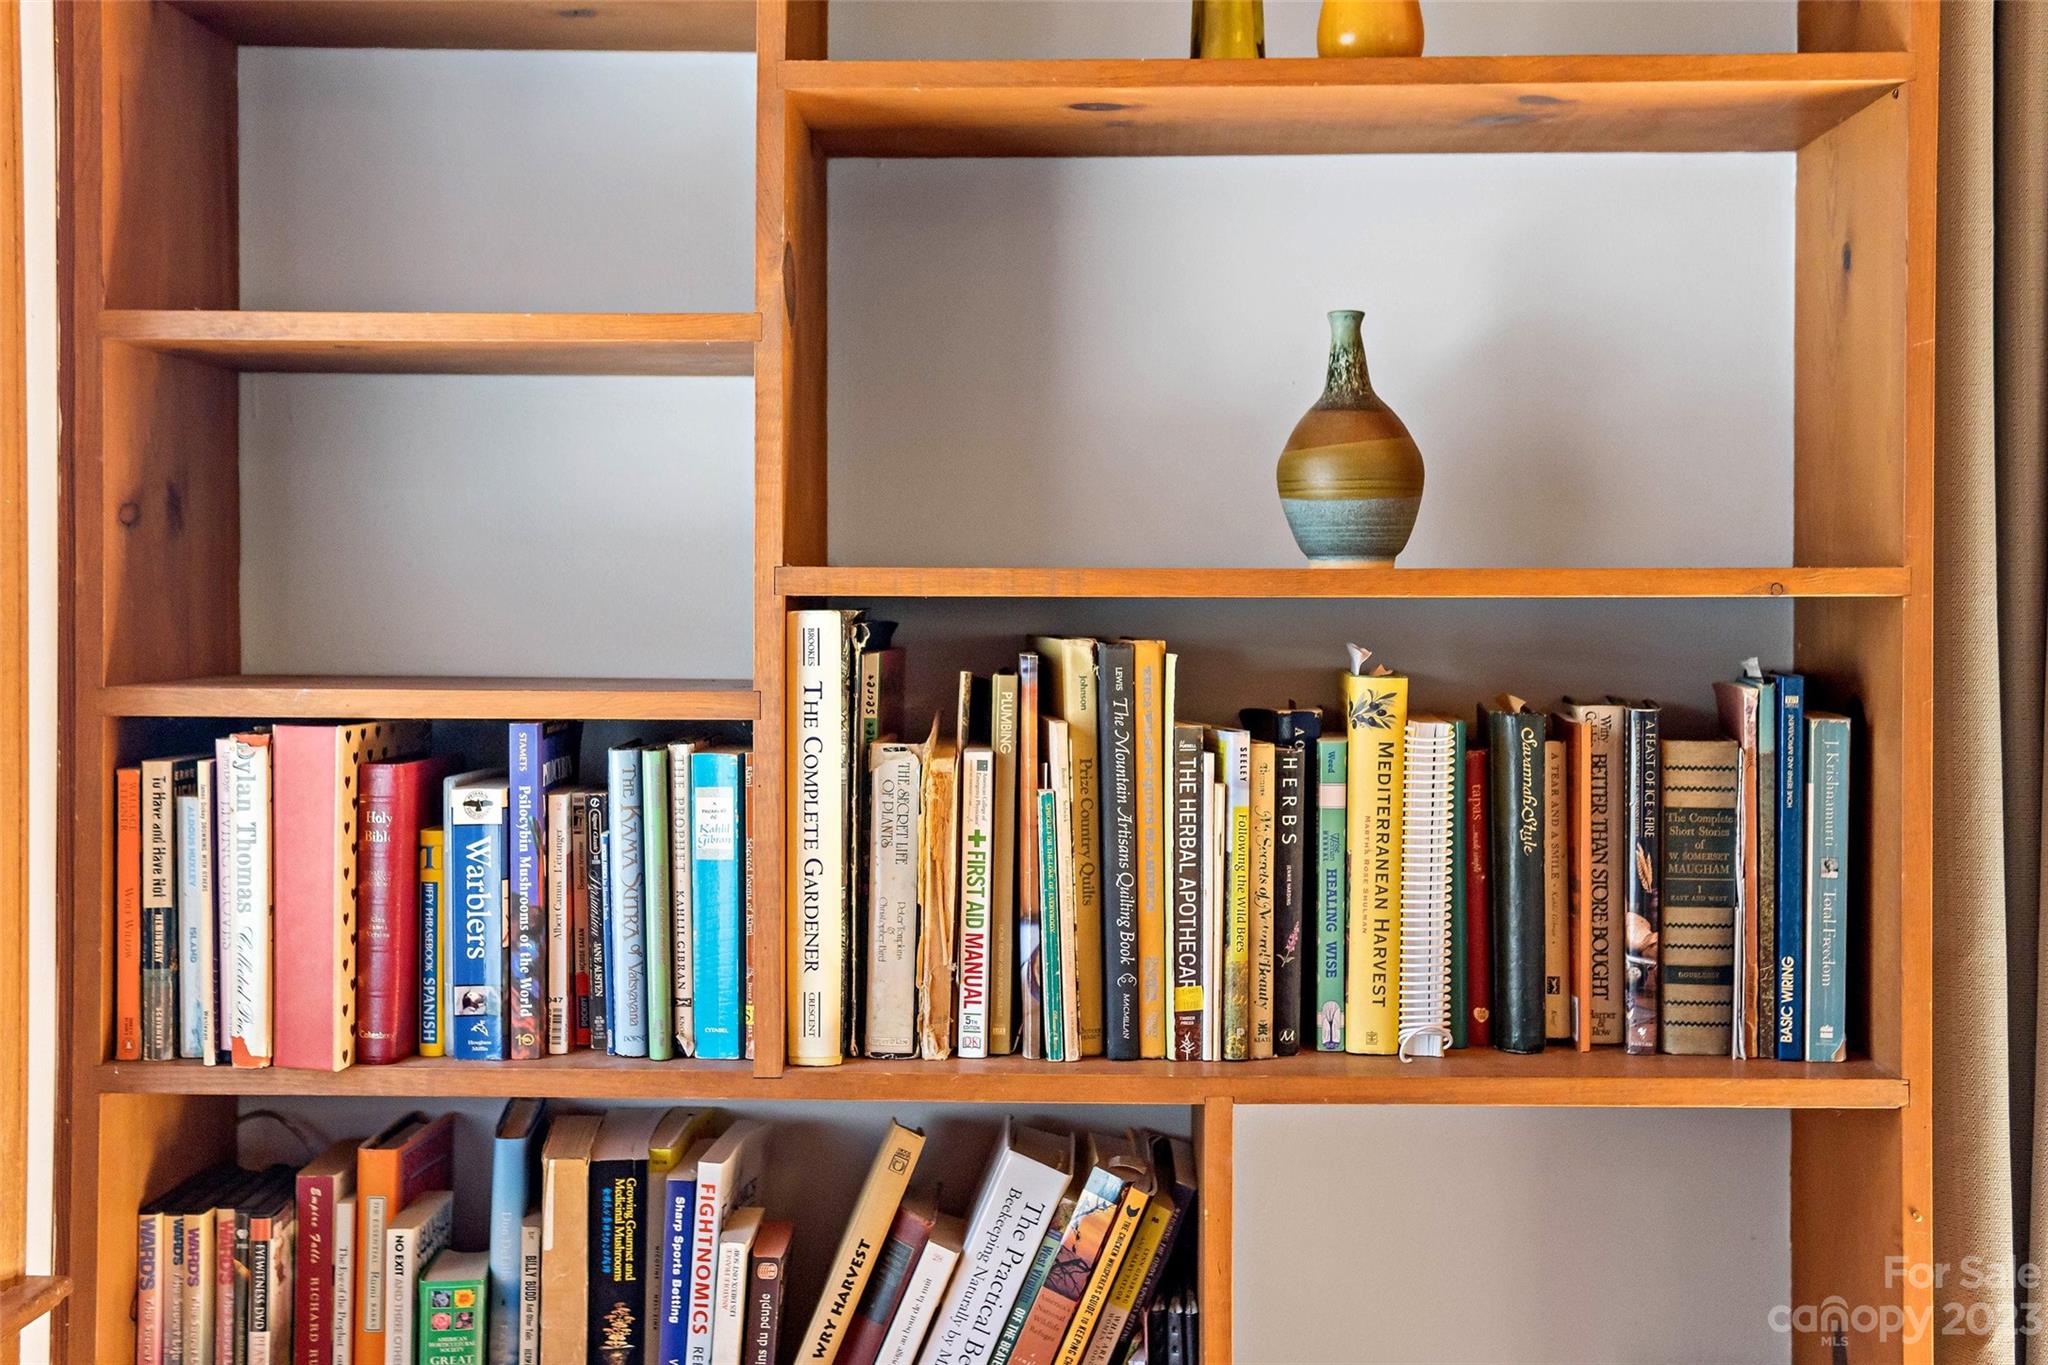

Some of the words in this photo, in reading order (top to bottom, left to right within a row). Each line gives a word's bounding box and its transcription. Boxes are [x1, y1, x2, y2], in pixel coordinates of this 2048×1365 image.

[807, 628, 816, 666] BROOKES
[803, 681, 823, 727] THE
[1079, 675, 1090, 711] Johnson
[1000, 691, 1012, 754] PLUMBING
[1113, 698, 1130, 726] The
[1644, 720, 1655, 730] A
[518, 732, 528, 772] STAMETS
[1328, 750, 1336, 773] Weed
[1644, 733, 1656, 767] FEAST
[1823, 739, 1838, 748] J.
[152, 776, 166, 788] To
[233, 744, 256, 812] Dylan
[622, 764, 638, 798] THE
[674, 755, 684, 789] THE
[898, 763, 910, 786] THE
[1080, 758, 1093, 794] Prize
[1114, 729, 1131, 804] Mountain
[1240, 746, 1248, 782] SEELEY
[1523, 726, 1538, 806] Savannah
[1644, 770, 1655, 786] OF
[803, 736, 823, 850] COMPLETE
[882, 779, 894, 799] OF
[1282, 757, 1298, 845] HERBS
[1591, 754, 1608, 816] BETTER
[1644, 790, 1655, 806] ICE
[1826, 752, 1839, 848] Krishnamurti
[120, 782, 128, 831] STEGNER
[128, 782, 137, 832] WALLACE
[152, 792, 166, 819] Have
[366, 811, 392, 827] Holy
[514, 786, 532, 852] Psilocybin
[896, 788, 910, 838] SECRET
[1666, 811, 1686, 823] The
[1689, 812, 1734, 825] Complete
[152, 823, 166, 844] and
[187, 806, 196, 847] ALDOUS
[620, 804, 644, 870] KAMA
[674, 797, 685, 872] PROPHET
[880, 801, 894, 848] PLANTS
[1078, 797, 1095, 858] Country
[1116, 806, 1132, 868] Artisans
[1234, 814, 1248, 872] Following
[1362, 816, 1372, 856] MARTHA
[1373, 741, 1394, 910] MEDITERRANEAN
[1520, 805, 1538, 856] Style
[1592, 818, 1608, 864] THAN
[1644, 816, 1655, 838] FIRE
[1669, 826, 1694, 837] Short
[1698, 826, 1730, 837] Stories
[152, 847, 166, 874] Have
[896, 842, 908, 865] LIFE
[1694, 839, 1706, 850] of
[188, 848, 196, 887] HUXLEY
[236, 822, 256, 913] Thomas
[966, 851, 986, 898] FIRST
[1080, 862, 1096, 906] Quilts
[1238, 874, 1248, 893] the
[1362, 858, 1371, 884] ROSE
[1668, 864, 1730, 874] MAUGHAM
[152, 878, 166, 898] Not
[424, 883, 434, 904] JIFFY
[465, 835, 492, 960] Warblers
[518, 856, 532, 930] Mushrooms
[554, 881, 562, 911] Camus
[1116, 871, 1135, 928] Quilting
[1326, 868, 1337, 932] HEALING
[1822, 888, 1837, 923] Total
[620, 872, 645, 942] SUTRA
[676, 890, 685, 937] KAHLIL
[803, 858, 824, 972] GARDENER
[897, 902, 906, 924] Peter
[966, 900, 984, 929] AID
[1236, 897, 1246, 924] Wild
[1362, 887, 1370, 934] SHULMAN
[154, 914, 164, 964] HEMINGWAY
[189, 927, 198, 963] ISLAND
[424, 908, 434, 972] PHRASEBOOK
[519, 934, 532, 950] of
[554, 914, 562, 941] Albert
[894, 926, 906, 960] Tompkins
[1236, 927, 1246, 953] Bees
[1592, 868, 1608, 1000] STORE-BOUGHT
[519, 952, 533, 974] the
[628, 944, 642, 957] of
[676, 940, 686, 990] GIBRAN
[1118, 930, 1134, 964] Book
[1326, 941, 1337, 978] WISE
[1372, 918, 1388, 1007] HARVEST
[1821, 927, 1836, 986] Freedom
[963, 932, 984, 1009] MANUAL
[1782, 956, 1794, 1004] WIRING
[423, 976, 436, 1041] SPANISH
[519, 977, 533, 1017] World
[626, 960, 643, 1026] Vatsyayana
[808, 992, 816, 1038] CRESCENT
[1122, 993, 1130, 1040] MACMILLAN
[1780, 1006, 1794, 1044] BASIC
[614, 1178, 625, 1224] Medicinal
[624, 1178, 637, 1219] Growing
[673, 1196, 686, 1232] Sharp
[338, 1246, 348, 1264] The
[614, 1226, 624, 1282] Mushrooms
[625, 1220, 636, 1262] Gourmet
[672, 1236, 684, 1275] Sports
[692, 1183, 716, 1335] FIGHTNOMICS
[1038, 1245, 1053, 1264] West
[336, 1266, 348, 1282] Eye
[626, 1263, 636, 1280] and
[921, 1278, 932, 1294] nuit
[1022, 1268, 1043, 1303] Virginia
[336, 1298, 346, 1310] the
[337, 1286, 347, 1297] of
[669, 1279, 683, 1324] Betting
[812, 1318, 837, 1359] WRY
[830, 1238, 871, 1316] HARVEST
[911, 1304, 920, 1315] de
[916, 1296, 924, 1305] la
[1041, 1293, 1070, 1312] America's
[334, 1312, 347, 1347] Prophet
[904, 1315, 916, 1334] bout
[1034, 1316, 1059, 1331] Wildlife
[1038, 1304, 1066, 1320] National
[902, 1331, 908, 1346] au
[430, 1355, 476, 1365] GREAT
